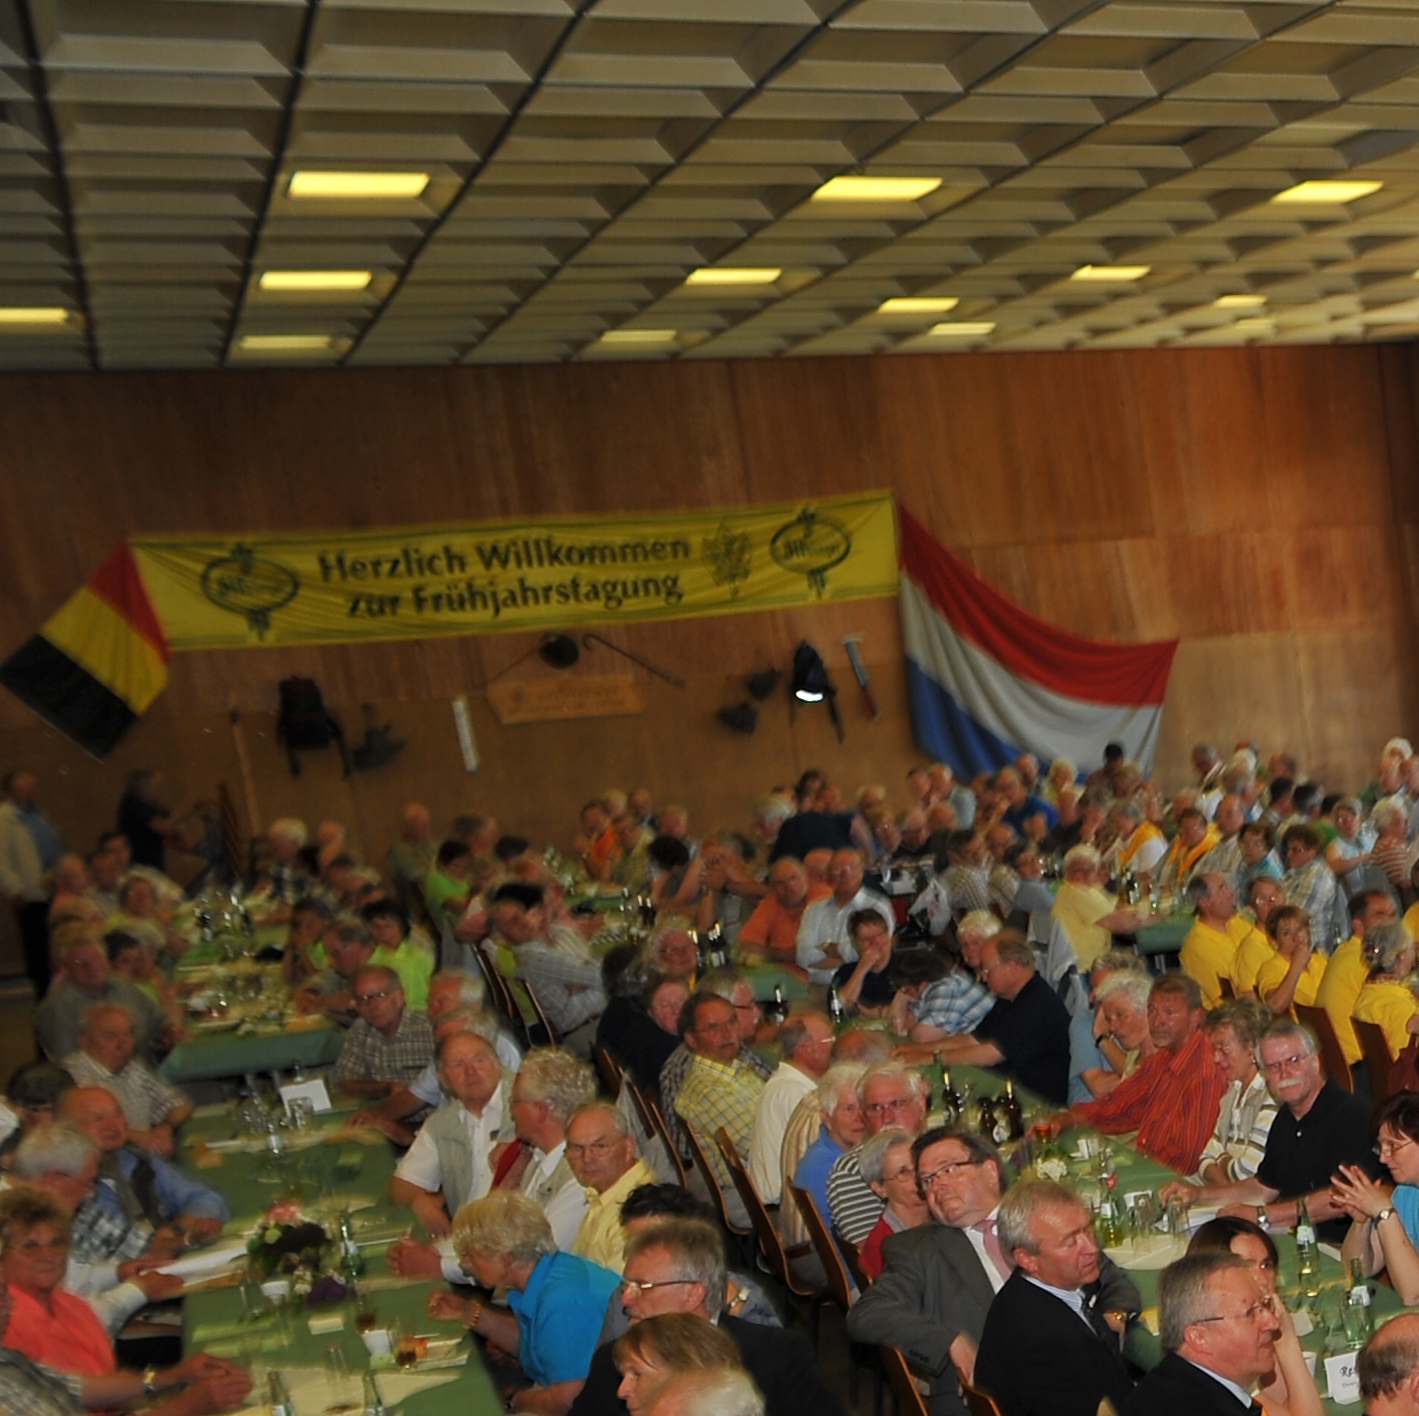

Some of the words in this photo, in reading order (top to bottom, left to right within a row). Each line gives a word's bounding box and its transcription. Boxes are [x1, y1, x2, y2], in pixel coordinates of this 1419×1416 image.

[319, 545, 467, 582] Herzlich
[475, 538, 690, 572] Willkommen
[348, 595, 401, 619] zur
[412, 575, 683, 617] Frühjahrstagung
